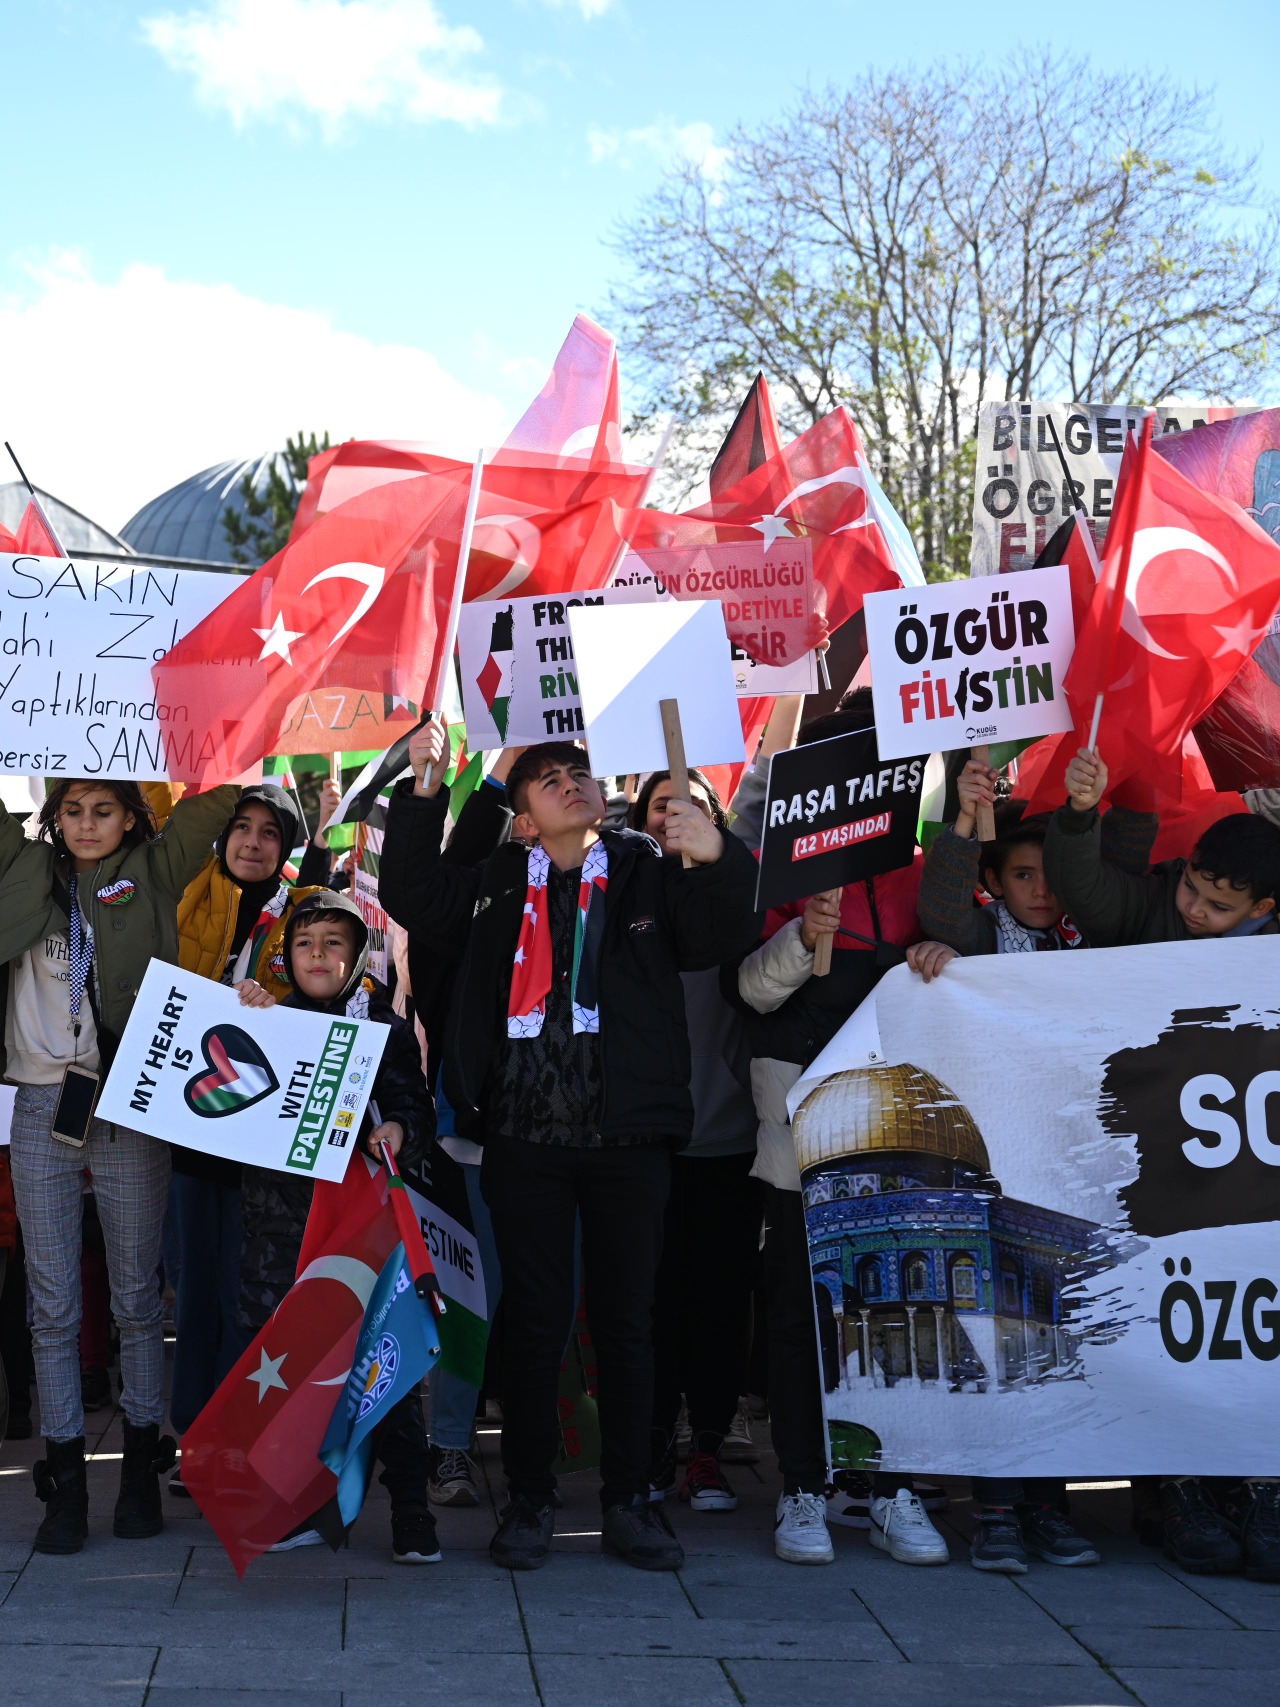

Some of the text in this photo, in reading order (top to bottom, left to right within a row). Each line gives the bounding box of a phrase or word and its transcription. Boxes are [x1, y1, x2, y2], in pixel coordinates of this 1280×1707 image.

[7, 557, 179, 606] SAKIN
[685, 561, 805, 593] ÖZGÜRLÜĞÜ
[895, 590, 1050, 665] ÖZGÜR
[283, 692, 379, 735] AZA
[84, 719, 244, 778] SANMA!
[770, 759, 922, 829] RAŞA TAFEŞ
[794, 812, 891, 858] (12 YAŞINDA)
[129, 985, 188, 1114] MY HEART
[171, 1047, 194, 1071] IS
[278, 1060, 315, 1119] WITH
[291, 1024, 354, 1164] PALESTINE
